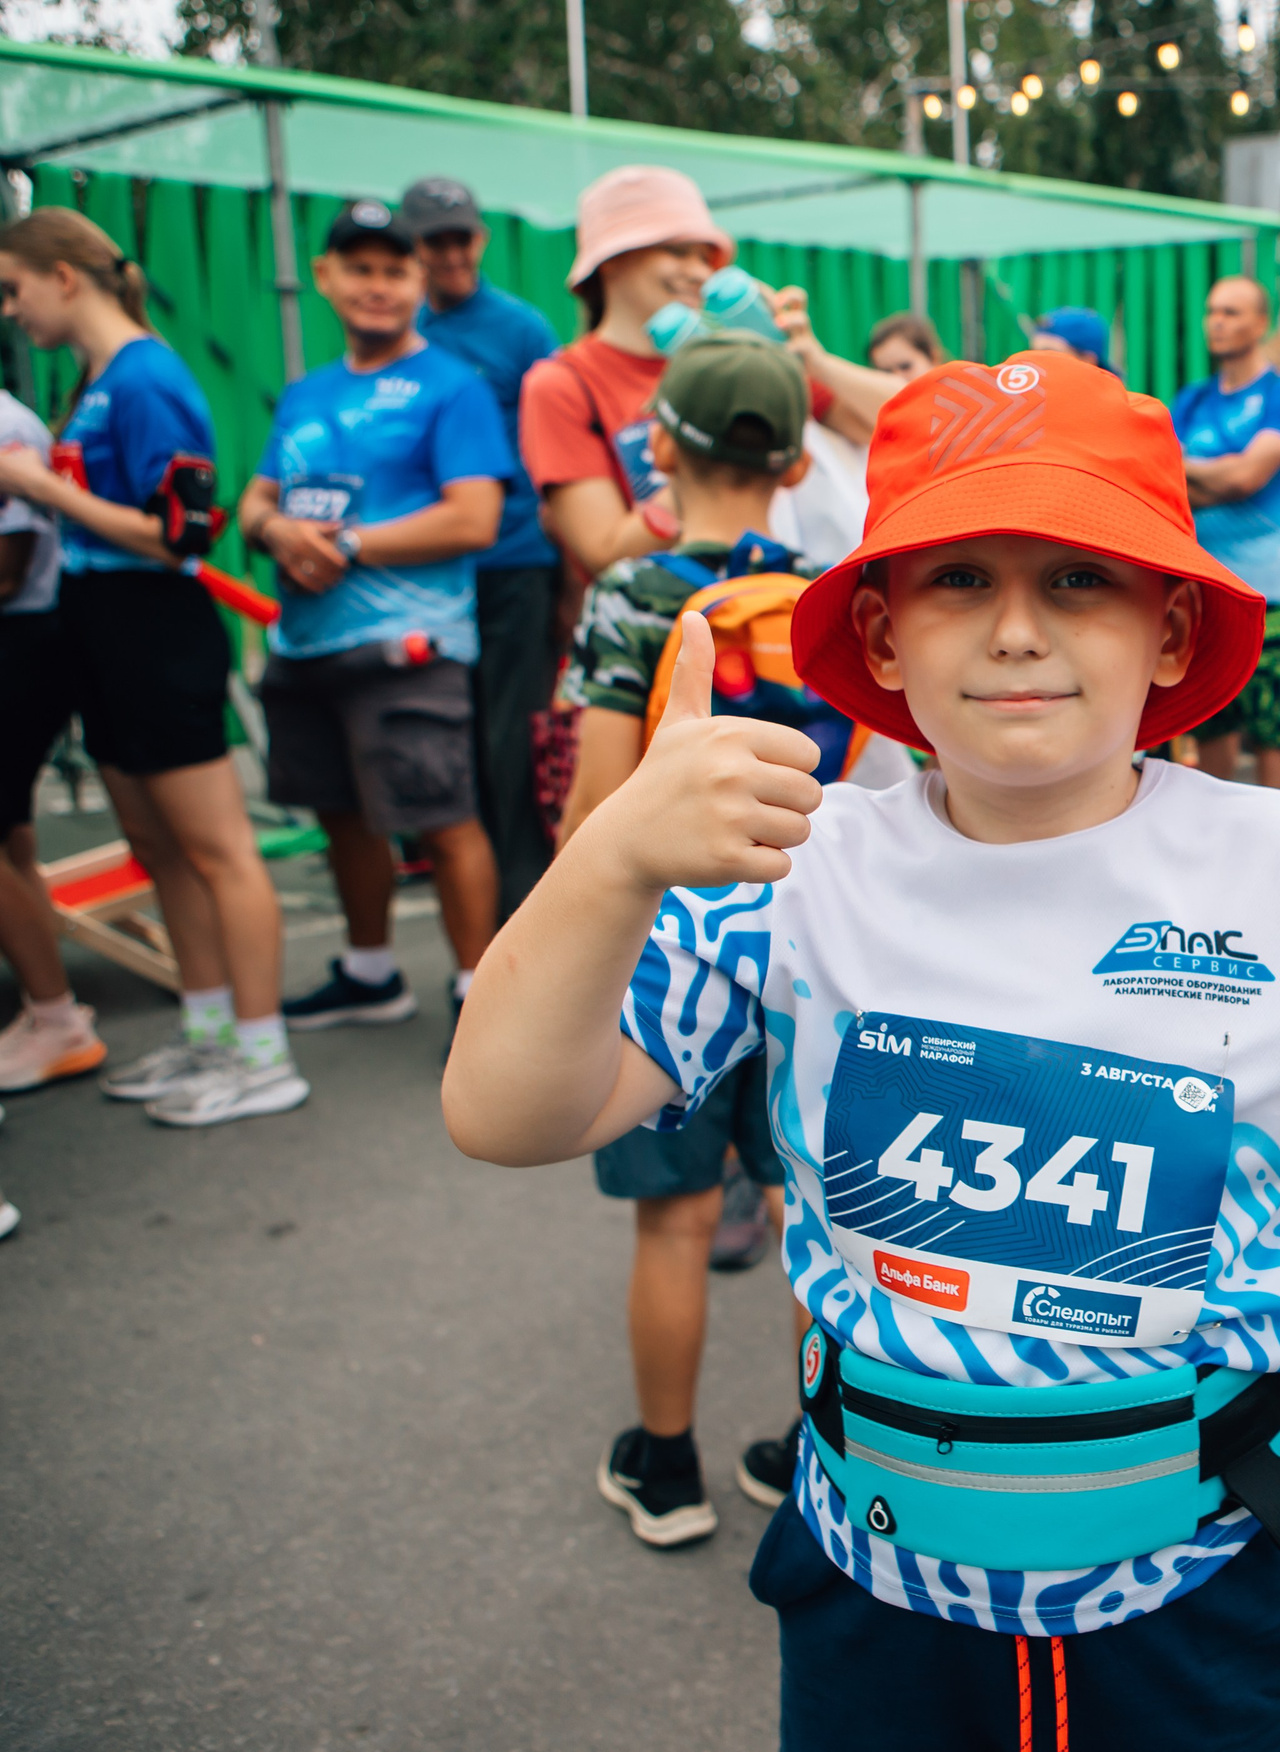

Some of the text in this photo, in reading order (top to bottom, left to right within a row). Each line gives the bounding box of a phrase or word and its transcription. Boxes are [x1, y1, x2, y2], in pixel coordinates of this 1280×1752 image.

[1008, 366, 1031, 388] 5
[1153, 956, 1256, 978] СЕРВИС
[1103, 977, 1262, 996] ЛАБОРАТОРНОЕ ОБОРУДОВАНИЕ
[1115, 987, 1250, 1005] АНАЛИТИЧЕСКИЕ ПРИБОРЫ
[922, 1036, 976, 1050] СИБИРСКИЙ
[920, 1050, 974, 1065] МАРАФОН
[1080, 1062, 1175, 1090] 3 АВГУСТА
[877, 1111, 1155, 1233] 4341
[881, 1262, 960, 1296] Альфа Банк
[1024, 1316, 1049, 1325] ТОВАРЫ
[1065, 1323, 1093, 1332] ТУРИЗМА
[1035, 1299, 1132, 1327] Следопыт
